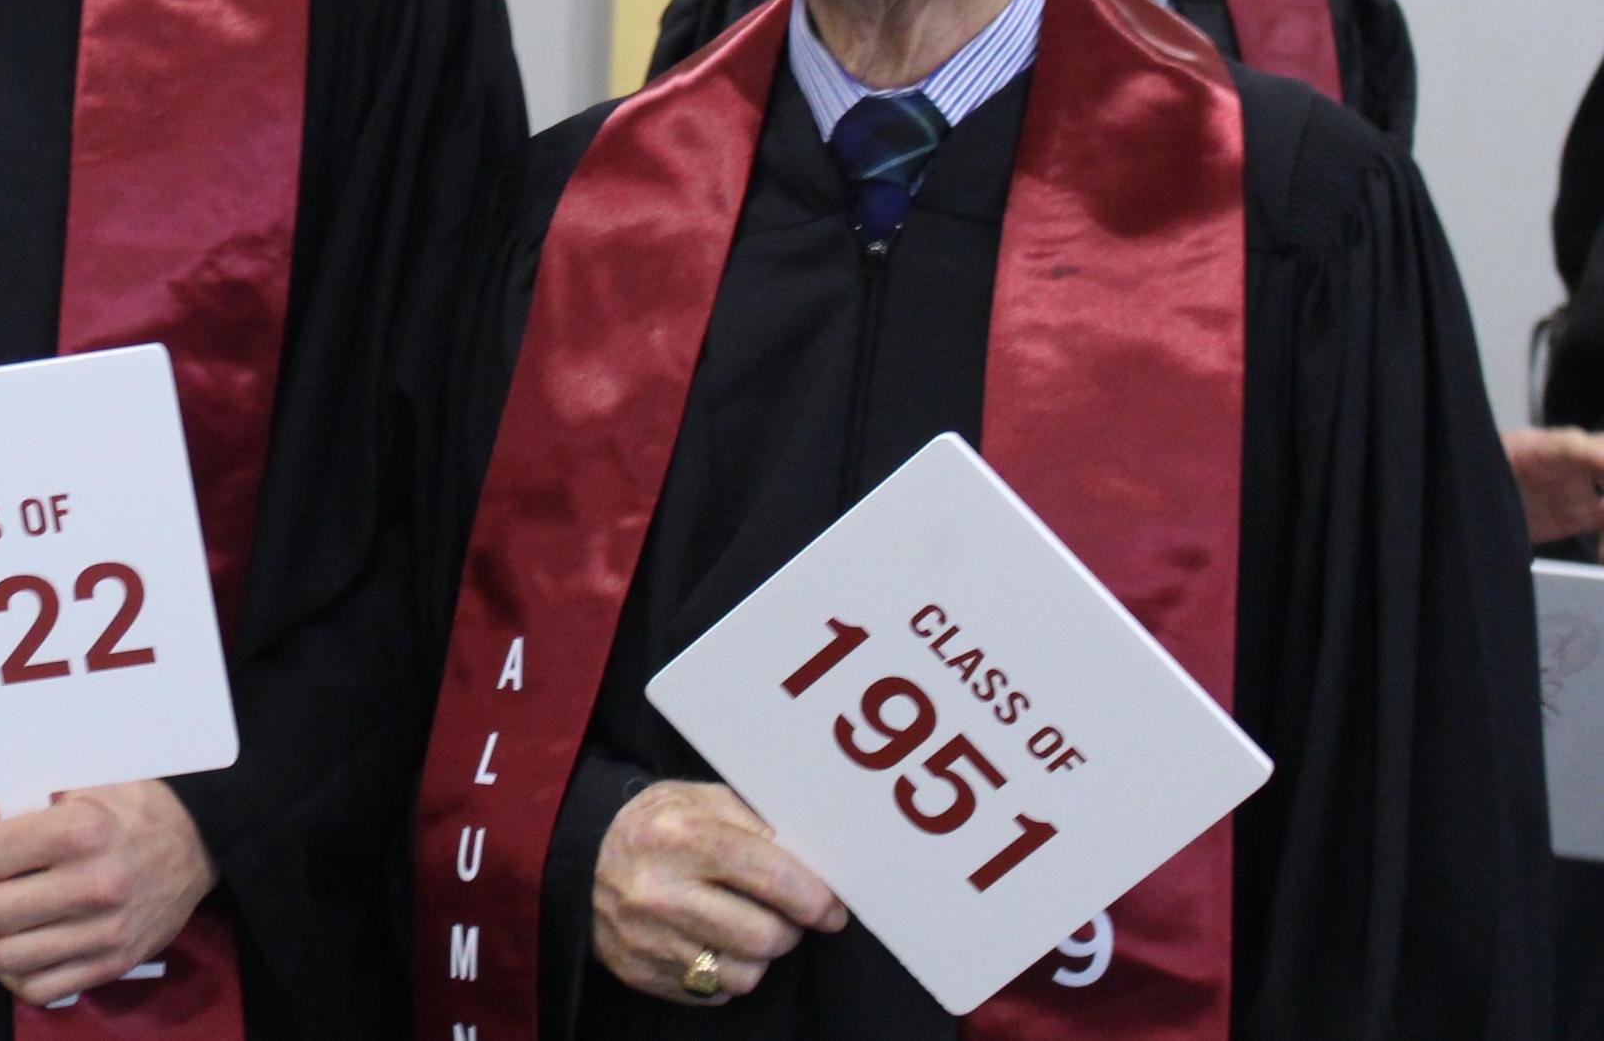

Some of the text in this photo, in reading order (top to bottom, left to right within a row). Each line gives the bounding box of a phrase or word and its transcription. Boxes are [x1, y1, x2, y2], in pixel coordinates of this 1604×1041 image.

[19, 493, 70, 537] OF
[779, 617, 1059, 894] 1951
[909, 603, 1088, 775] CLASS OF
